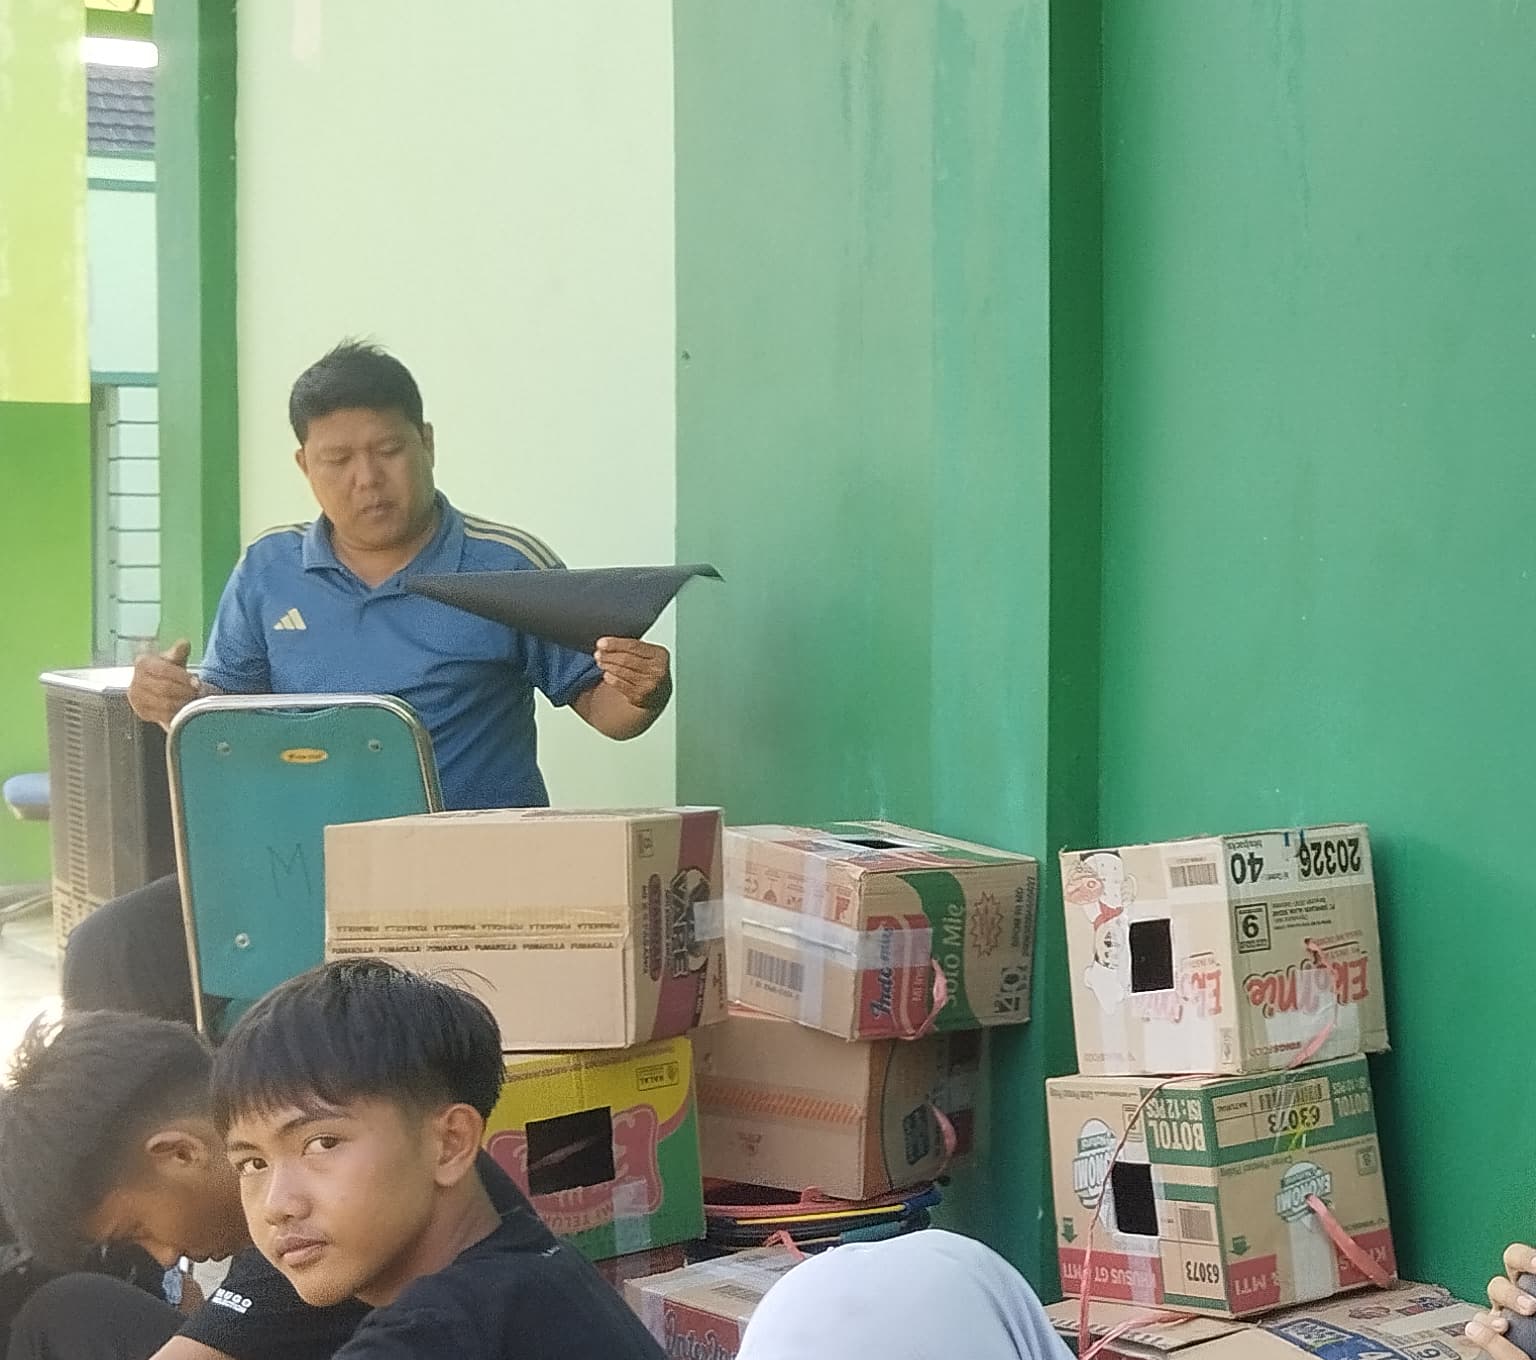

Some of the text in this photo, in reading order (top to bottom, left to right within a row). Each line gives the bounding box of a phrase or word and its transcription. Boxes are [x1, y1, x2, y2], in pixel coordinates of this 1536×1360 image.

[1230, 851, 1265, 885] 40
[1299, 836, 1361, 878] 20326
[1148, 1121, 1208, 1152] BOTOL
[1185, 1259, 1220, 1285] 63073
